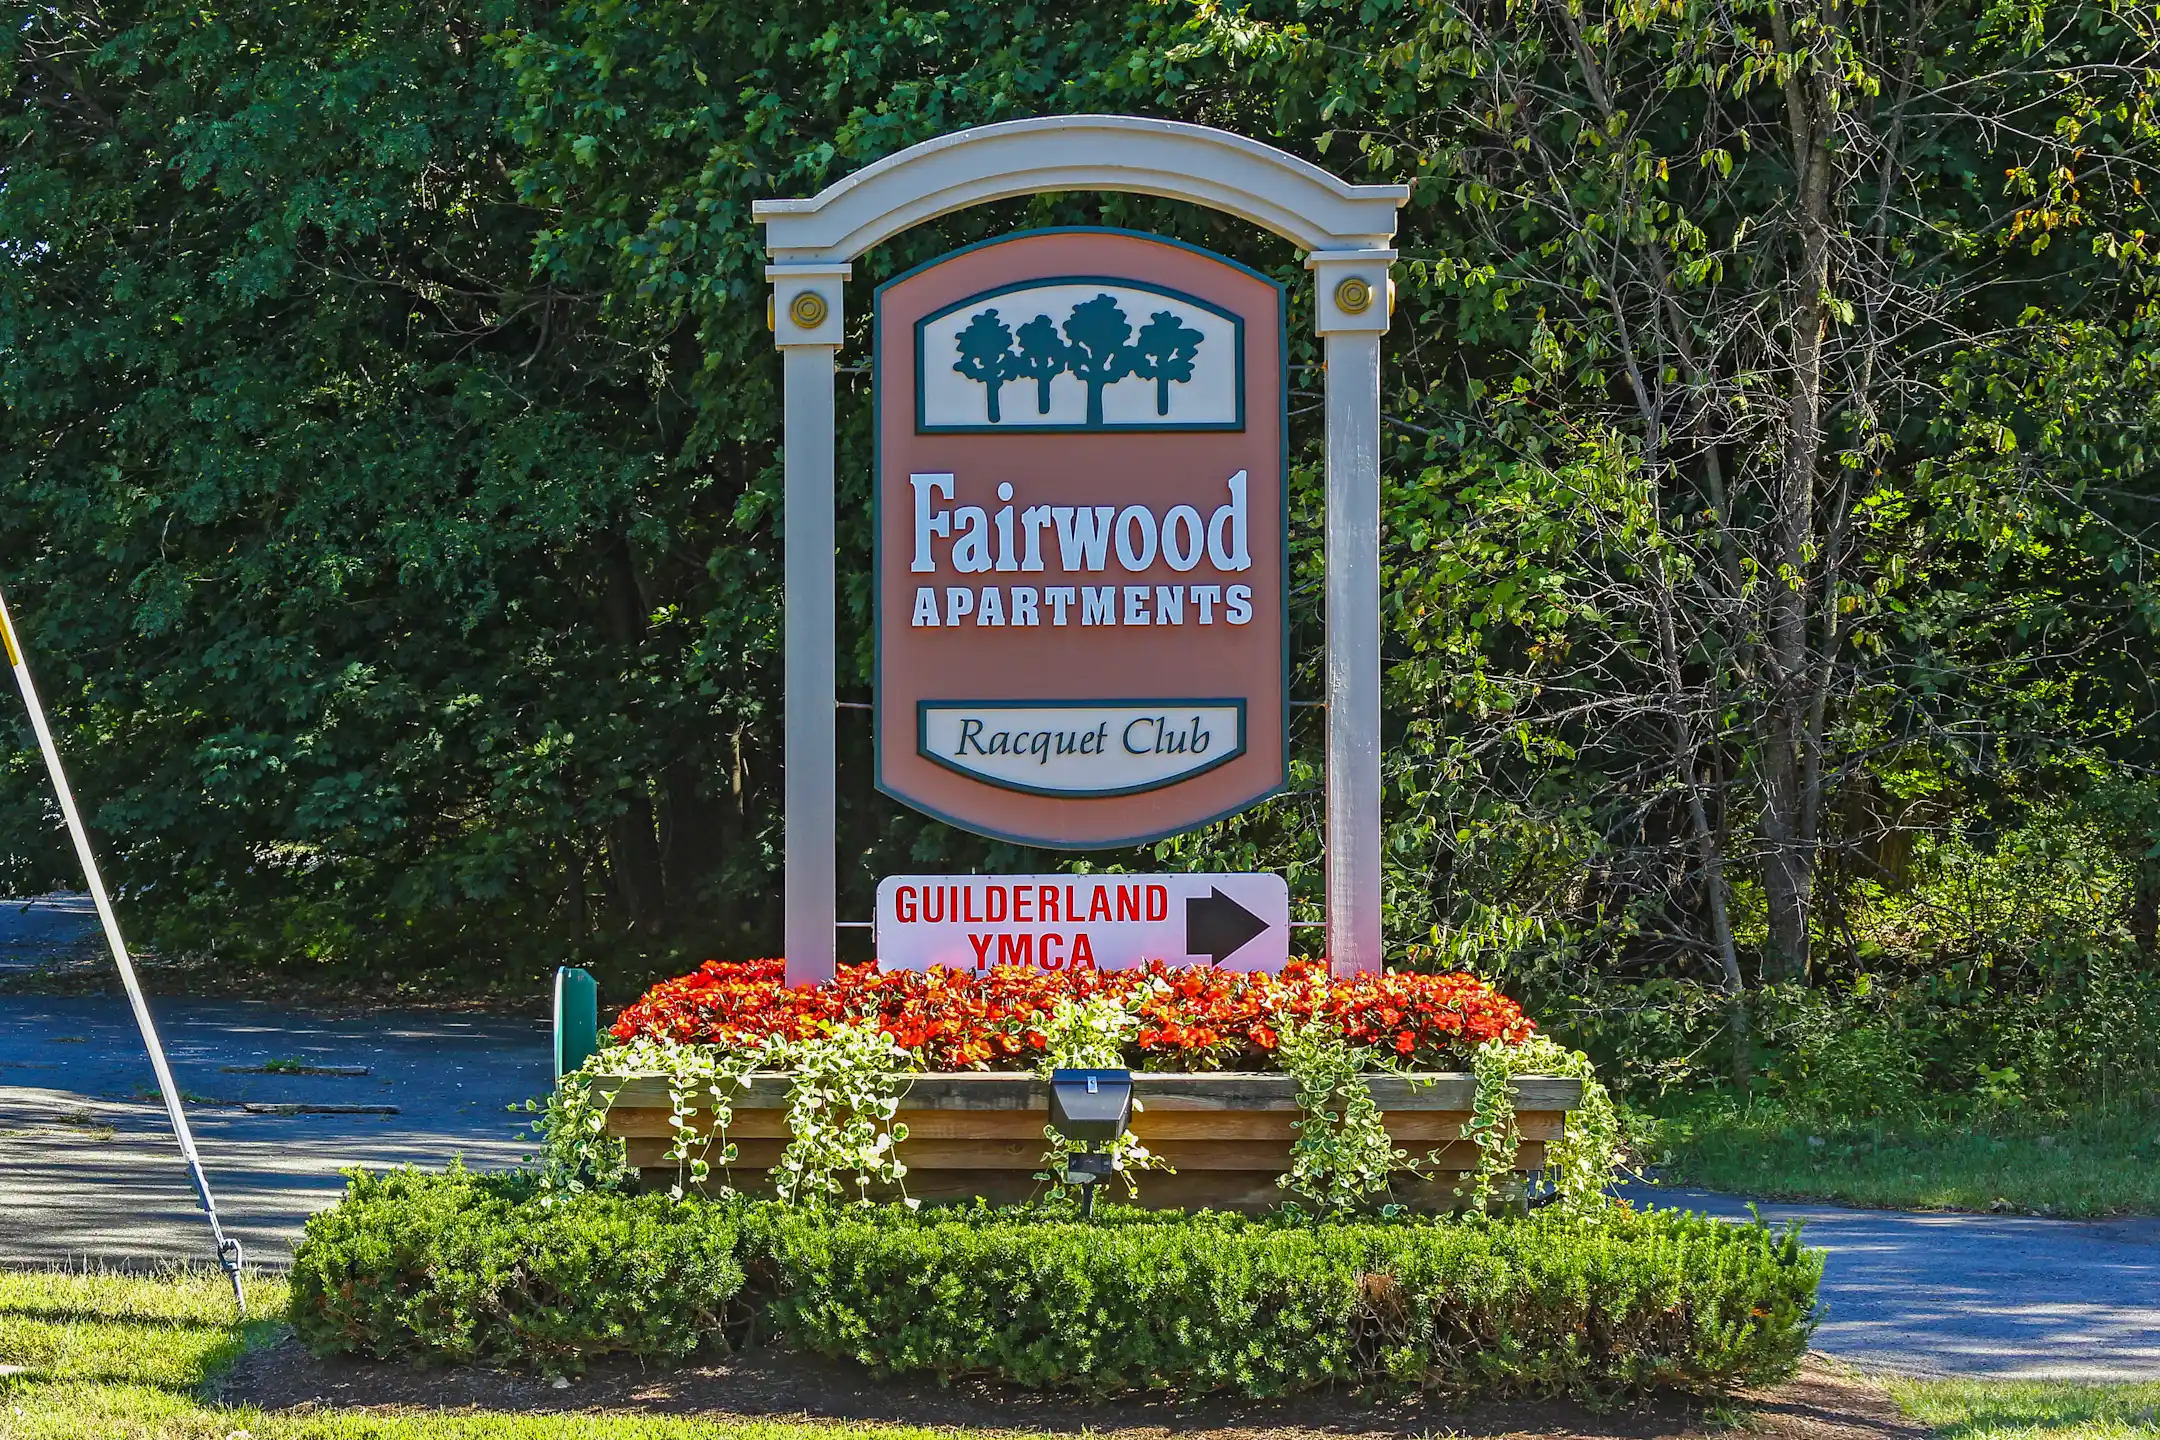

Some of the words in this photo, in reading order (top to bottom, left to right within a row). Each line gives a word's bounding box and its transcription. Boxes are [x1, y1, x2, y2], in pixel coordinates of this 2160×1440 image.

[910, 469, 1252, 573] Fairwood
[911, 584, 1253, 627] APARTMENTS
[954, 718, 1108, 765] Racquet
[1122, 716, 1211, 755] Club
[895, 884, 1169, 923] GUILDERLAND
[968, 933, 1096, 971] YMCA
